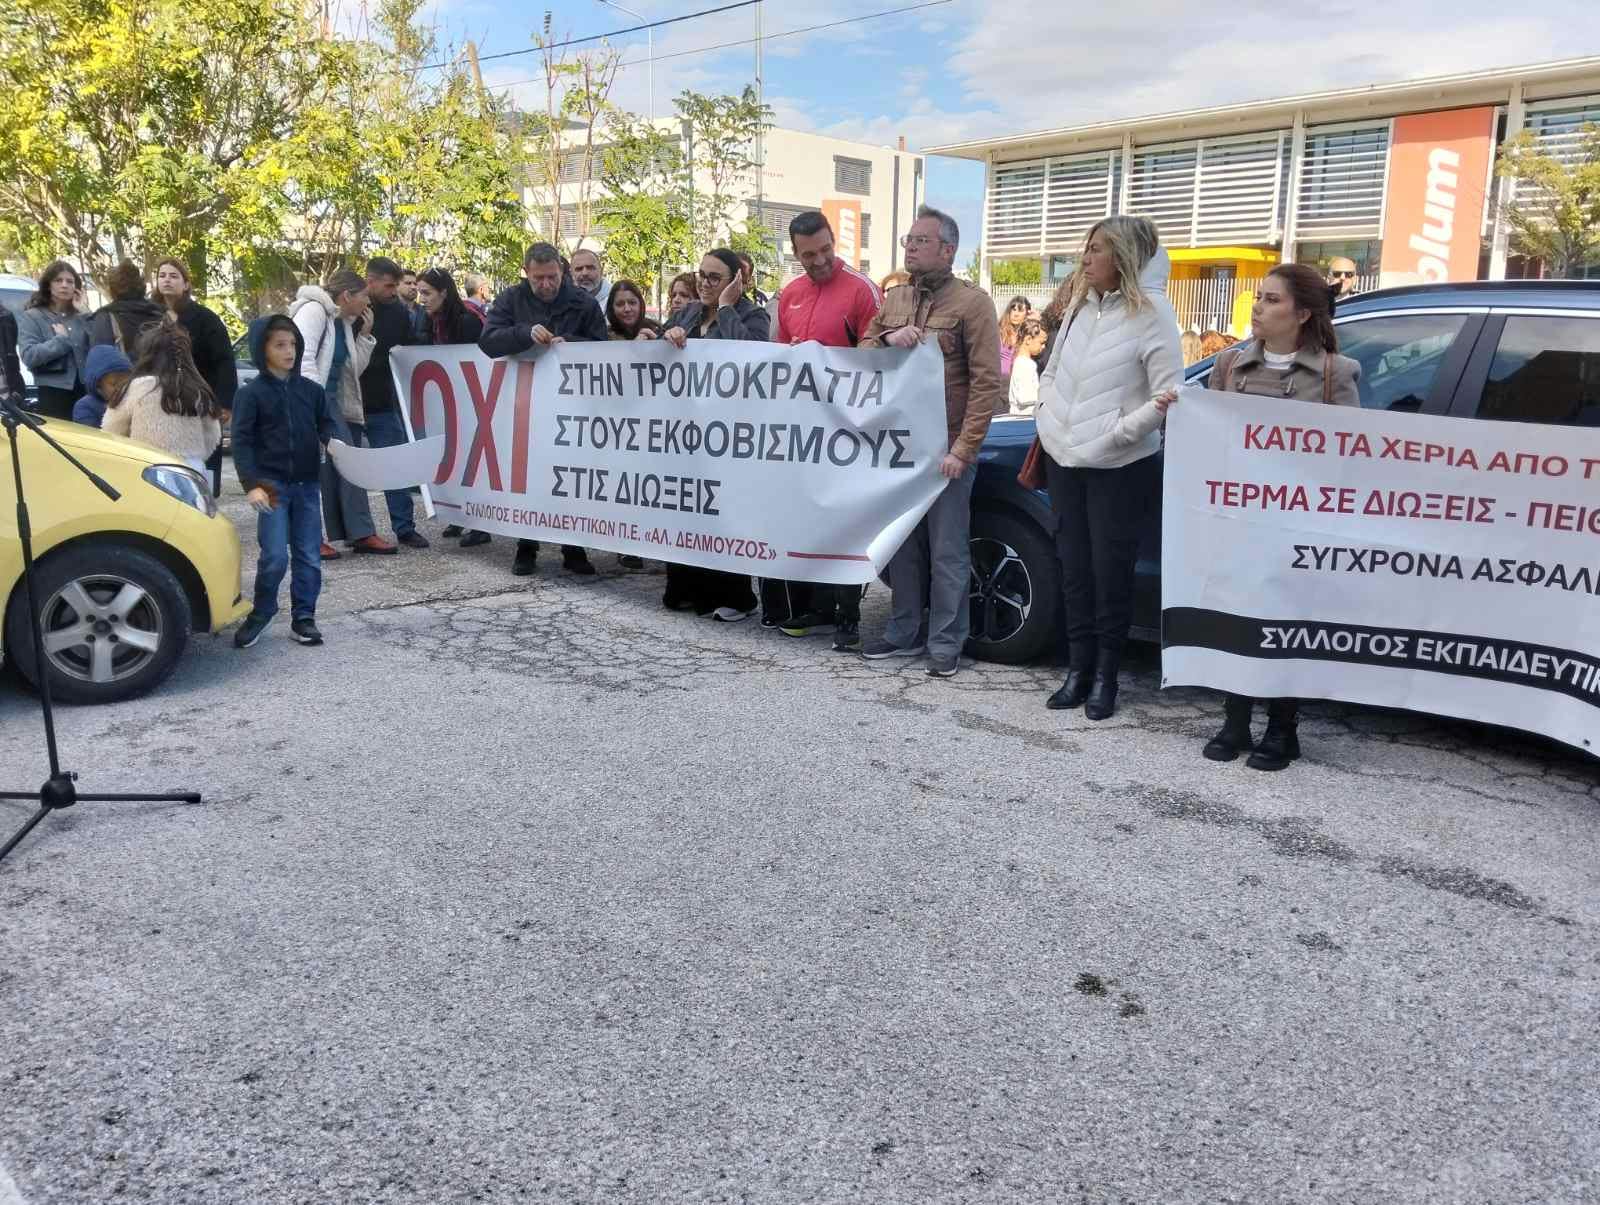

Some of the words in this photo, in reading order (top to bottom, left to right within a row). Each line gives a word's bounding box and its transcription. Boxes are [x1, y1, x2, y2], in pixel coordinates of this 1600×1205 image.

[558, 363, 623, 396] ΣΤΗΝ
[630, 361, 884, 408] ΤΡΟΜΟΚΡΑΤΙΑ
[554, 414, 640, 451] ΣΤΟΥΣ
[648, 418, 915, 469] ΕΚΦΟΒΙΣΜΟΥΣ
[1244, 424, 1326, 454] ΚΑΤΩ
[1335, 431, 1372, 458] ΤΑ
[1380, 437, 1480, 471] ΧΕΡΙΑ
[1486, 451, 1569, 476] ΑΠΟ
[551, 465, 609, 502] ΣΤΙΣ
[615, 471, 721, 516] ΔΙΩΞΕΙΣ
[1206, 481, 1309, 512] ΤΕΡΜΑ
[1317, 486, 1356, 514] ΣΕ
[1363, 490, 1496, 524] ΔΙΩΞΕΙΣ
[465, 501, 510, 523] ΣΥΛΛΟΓΟΣ
[512, 508, 615, 537] ΕΚΠΑΙΔΕΥΤΙΚΩΝ
[618, 521, 641, 541] Π.Ε.
[644, 527, 672, 546] «ΑΛ.
[675, 531, 777, 560] ΔΕΛΜΟΥΖΟΣ»
[1291, 544, 1464, 580] ΣΥΓΧΡΟΝΑ
[1472, 557, 1600, 596] ΑΣΦΑΛ
[1260, 627, 1410, 659] ΣΥΛΛΟΓΟΣ
